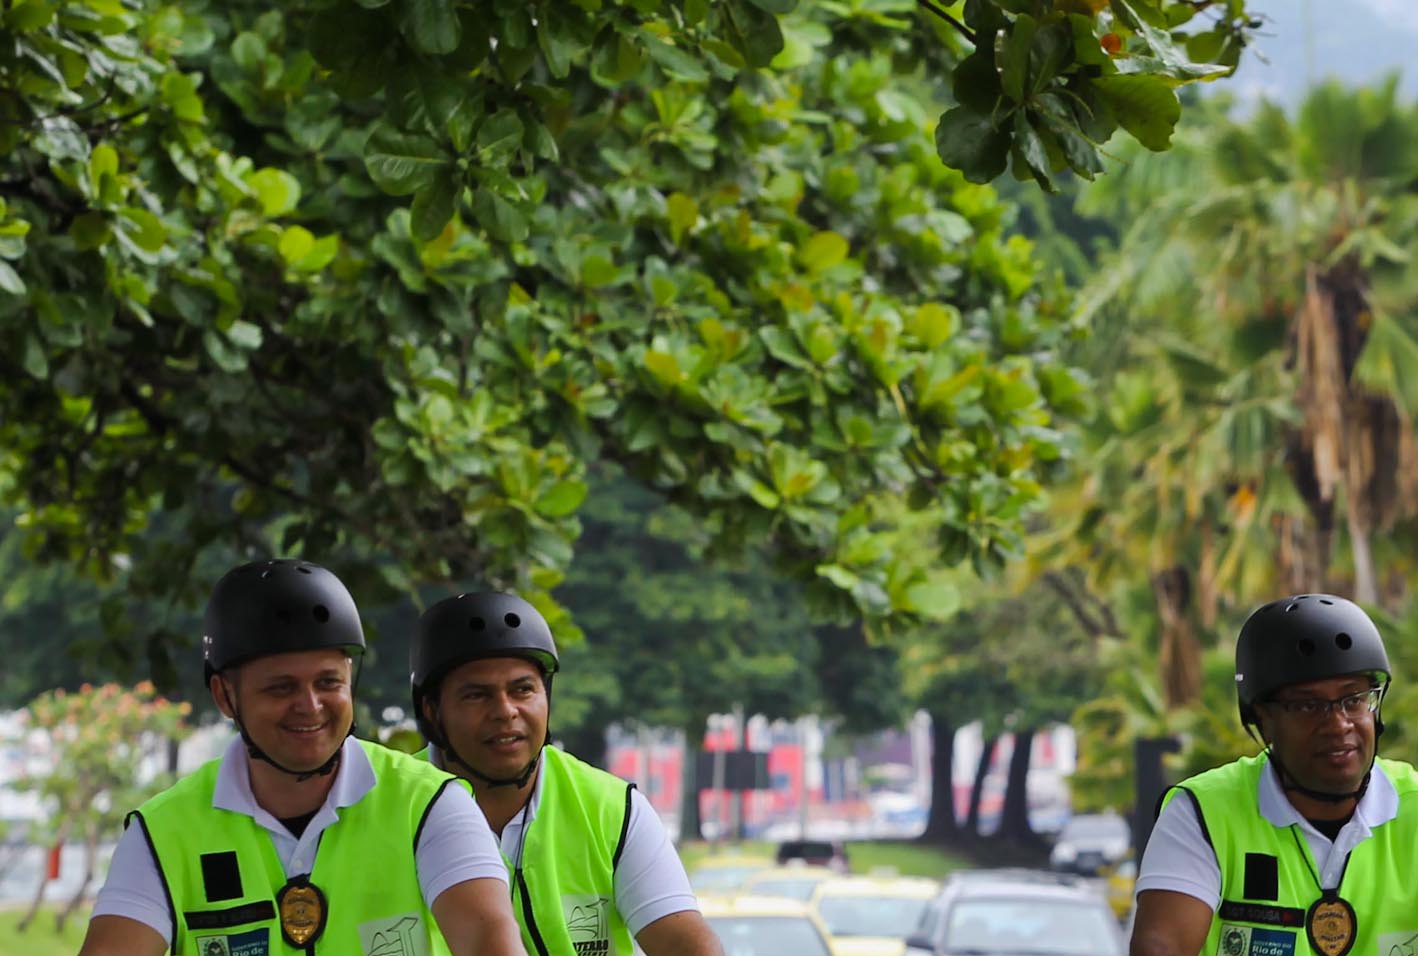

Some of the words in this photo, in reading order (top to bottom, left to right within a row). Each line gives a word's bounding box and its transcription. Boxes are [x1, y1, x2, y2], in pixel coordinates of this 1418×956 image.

[251, 947, 264, 956] de
[1252, 945, 1269, 955] Rio
[1270, 947, 1284, 956] de
